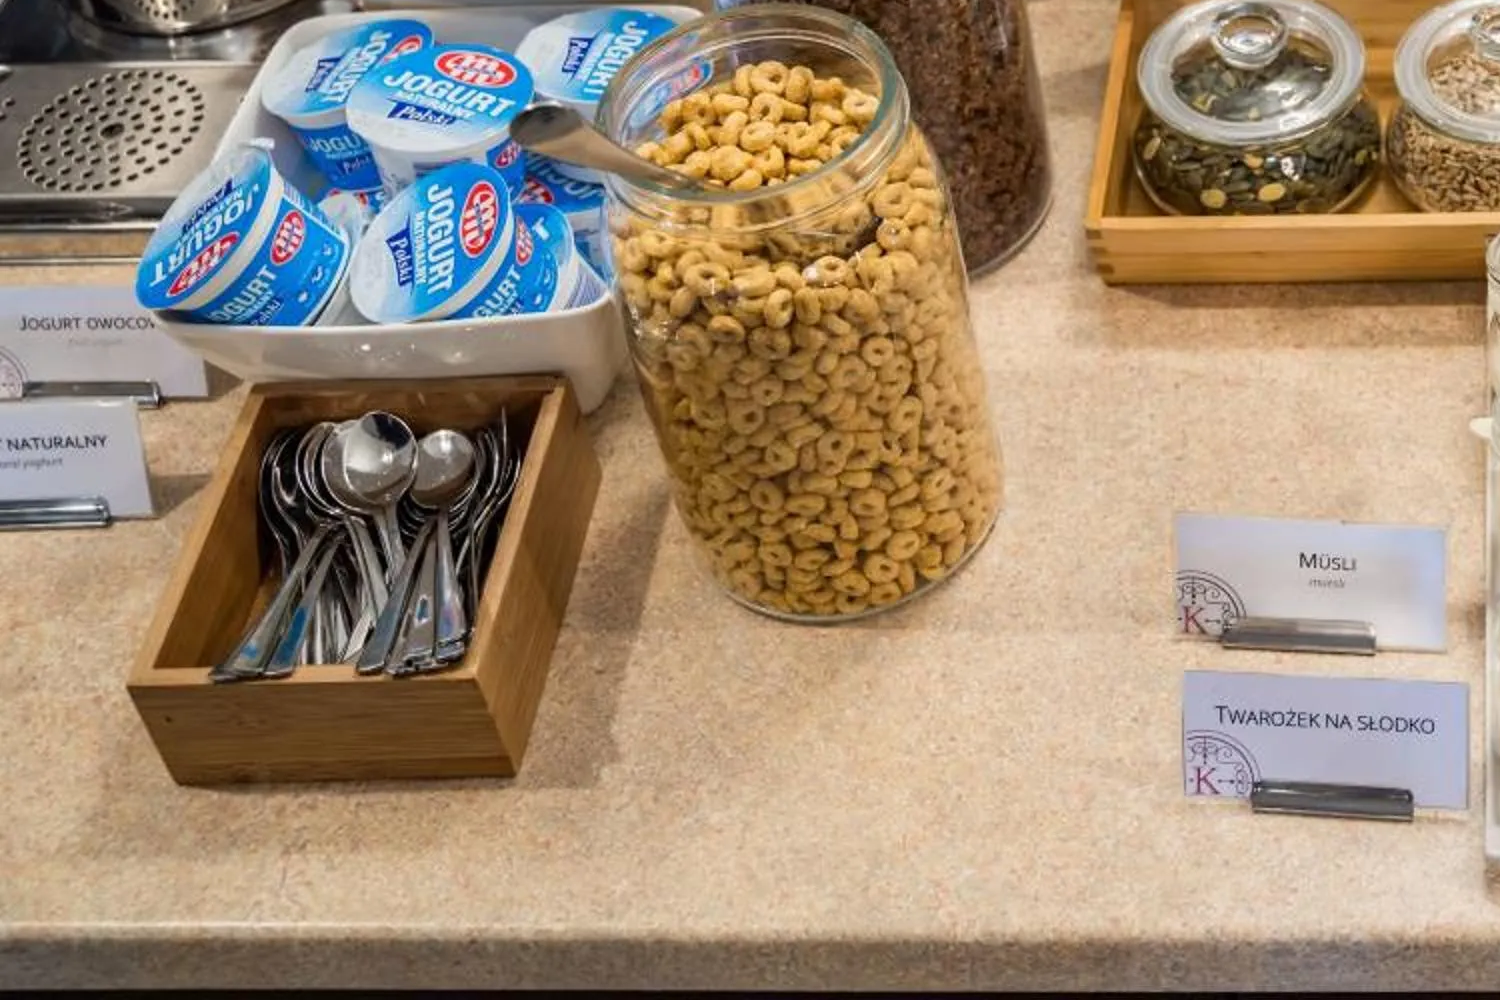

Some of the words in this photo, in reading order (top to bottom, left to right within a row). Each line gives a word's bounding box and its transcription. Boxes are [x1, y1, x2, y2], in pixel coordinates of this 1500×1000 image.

[384, 71, 518, 118] JOGURT
[427, 183, 455, 295] JOGURT
[472, 264, 522, 318] GURT
[20, 316, 81, 331] JOGURT
[87, 316, 156, 331] OWOCO
[7, 435, 108, 452] NATURALNY
[1215, 705, 1321, 729] TWAROŻEK
[1325, 713, 1352, 731] NA
[1357, 713, 1436, 735] SŁODKO
